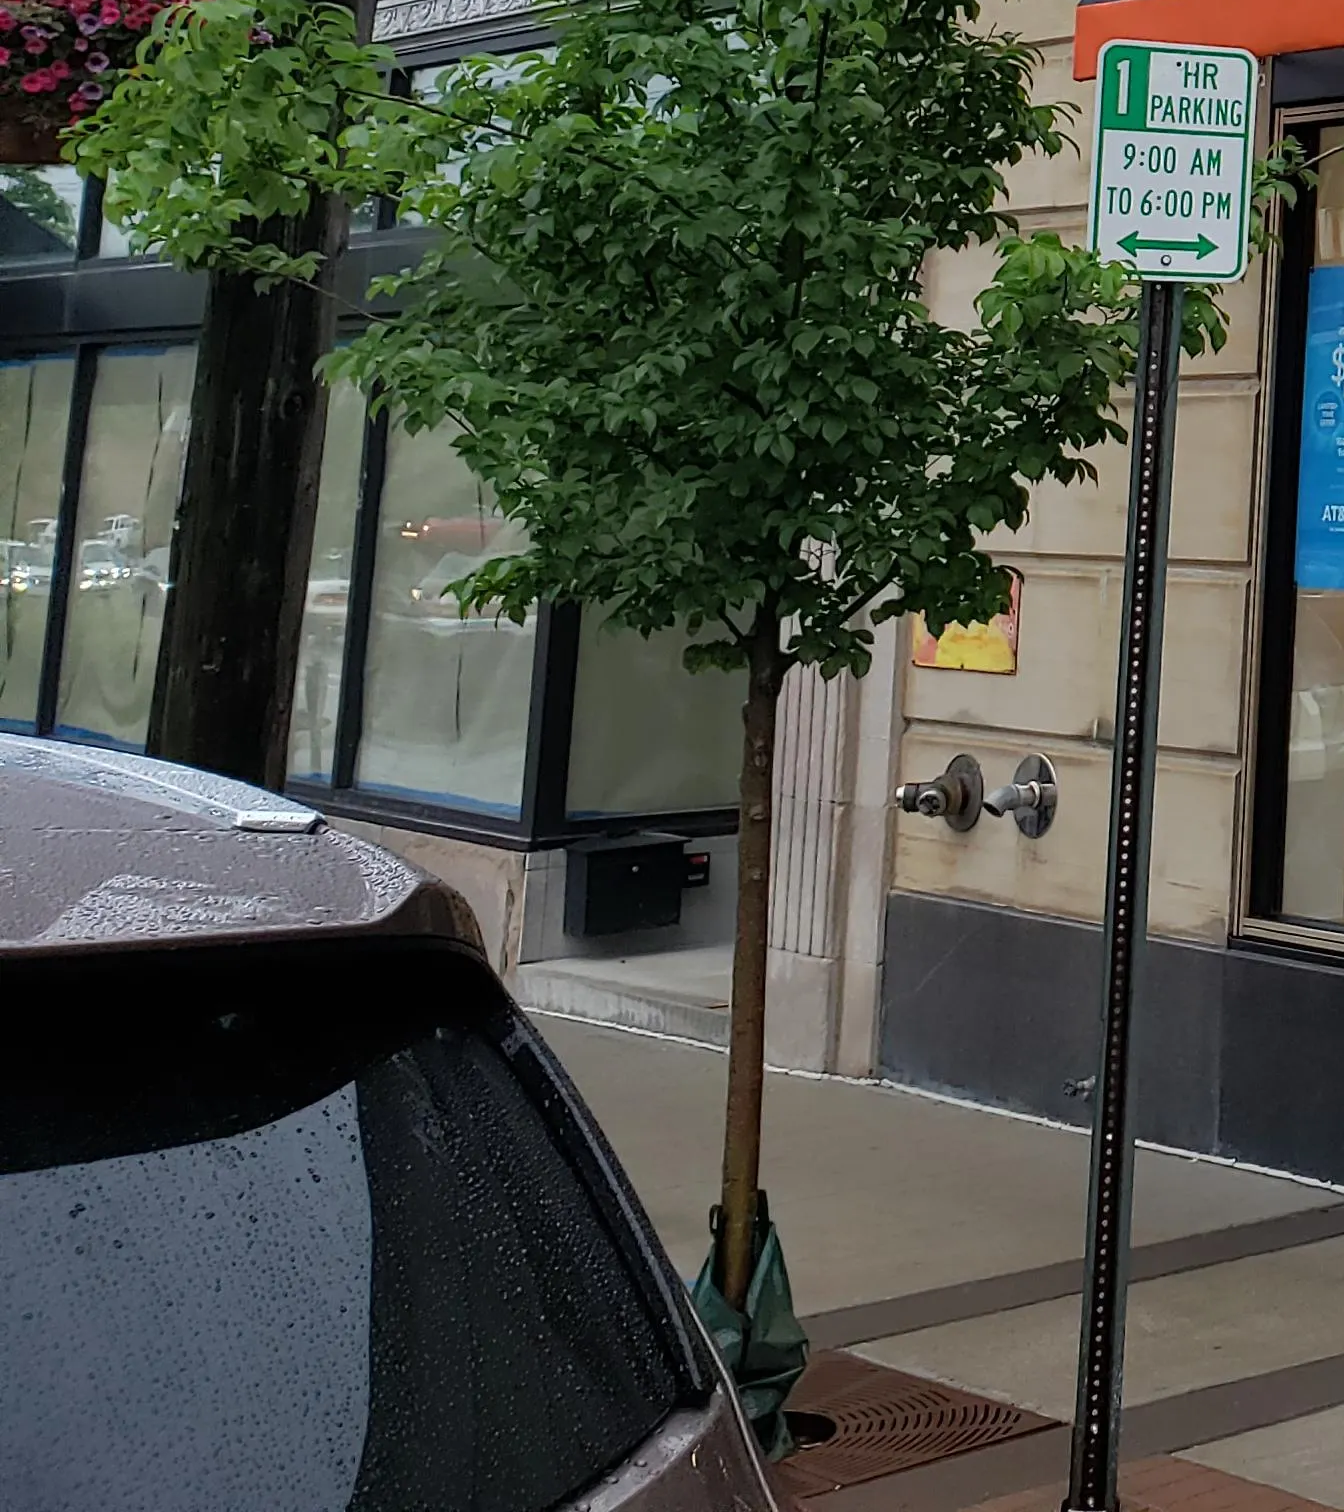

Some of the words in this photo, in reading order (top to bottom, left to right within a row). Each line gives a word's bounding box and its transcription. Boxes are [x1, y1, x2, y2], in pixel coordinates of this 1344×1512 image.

[1116, 59, 1131, 115] 1
[1183, 61, 1219, 90] HR
[1151, 95, 1243, 127] PARKING
[1122, 143, 1177, 174] 9:00
[1190, 148, 1222, 177] AM
[1107, 187, 1132, 215] TO
[1140, 189, 1193, 218] 6:00
[1202, 192, 1232, 220] PM
